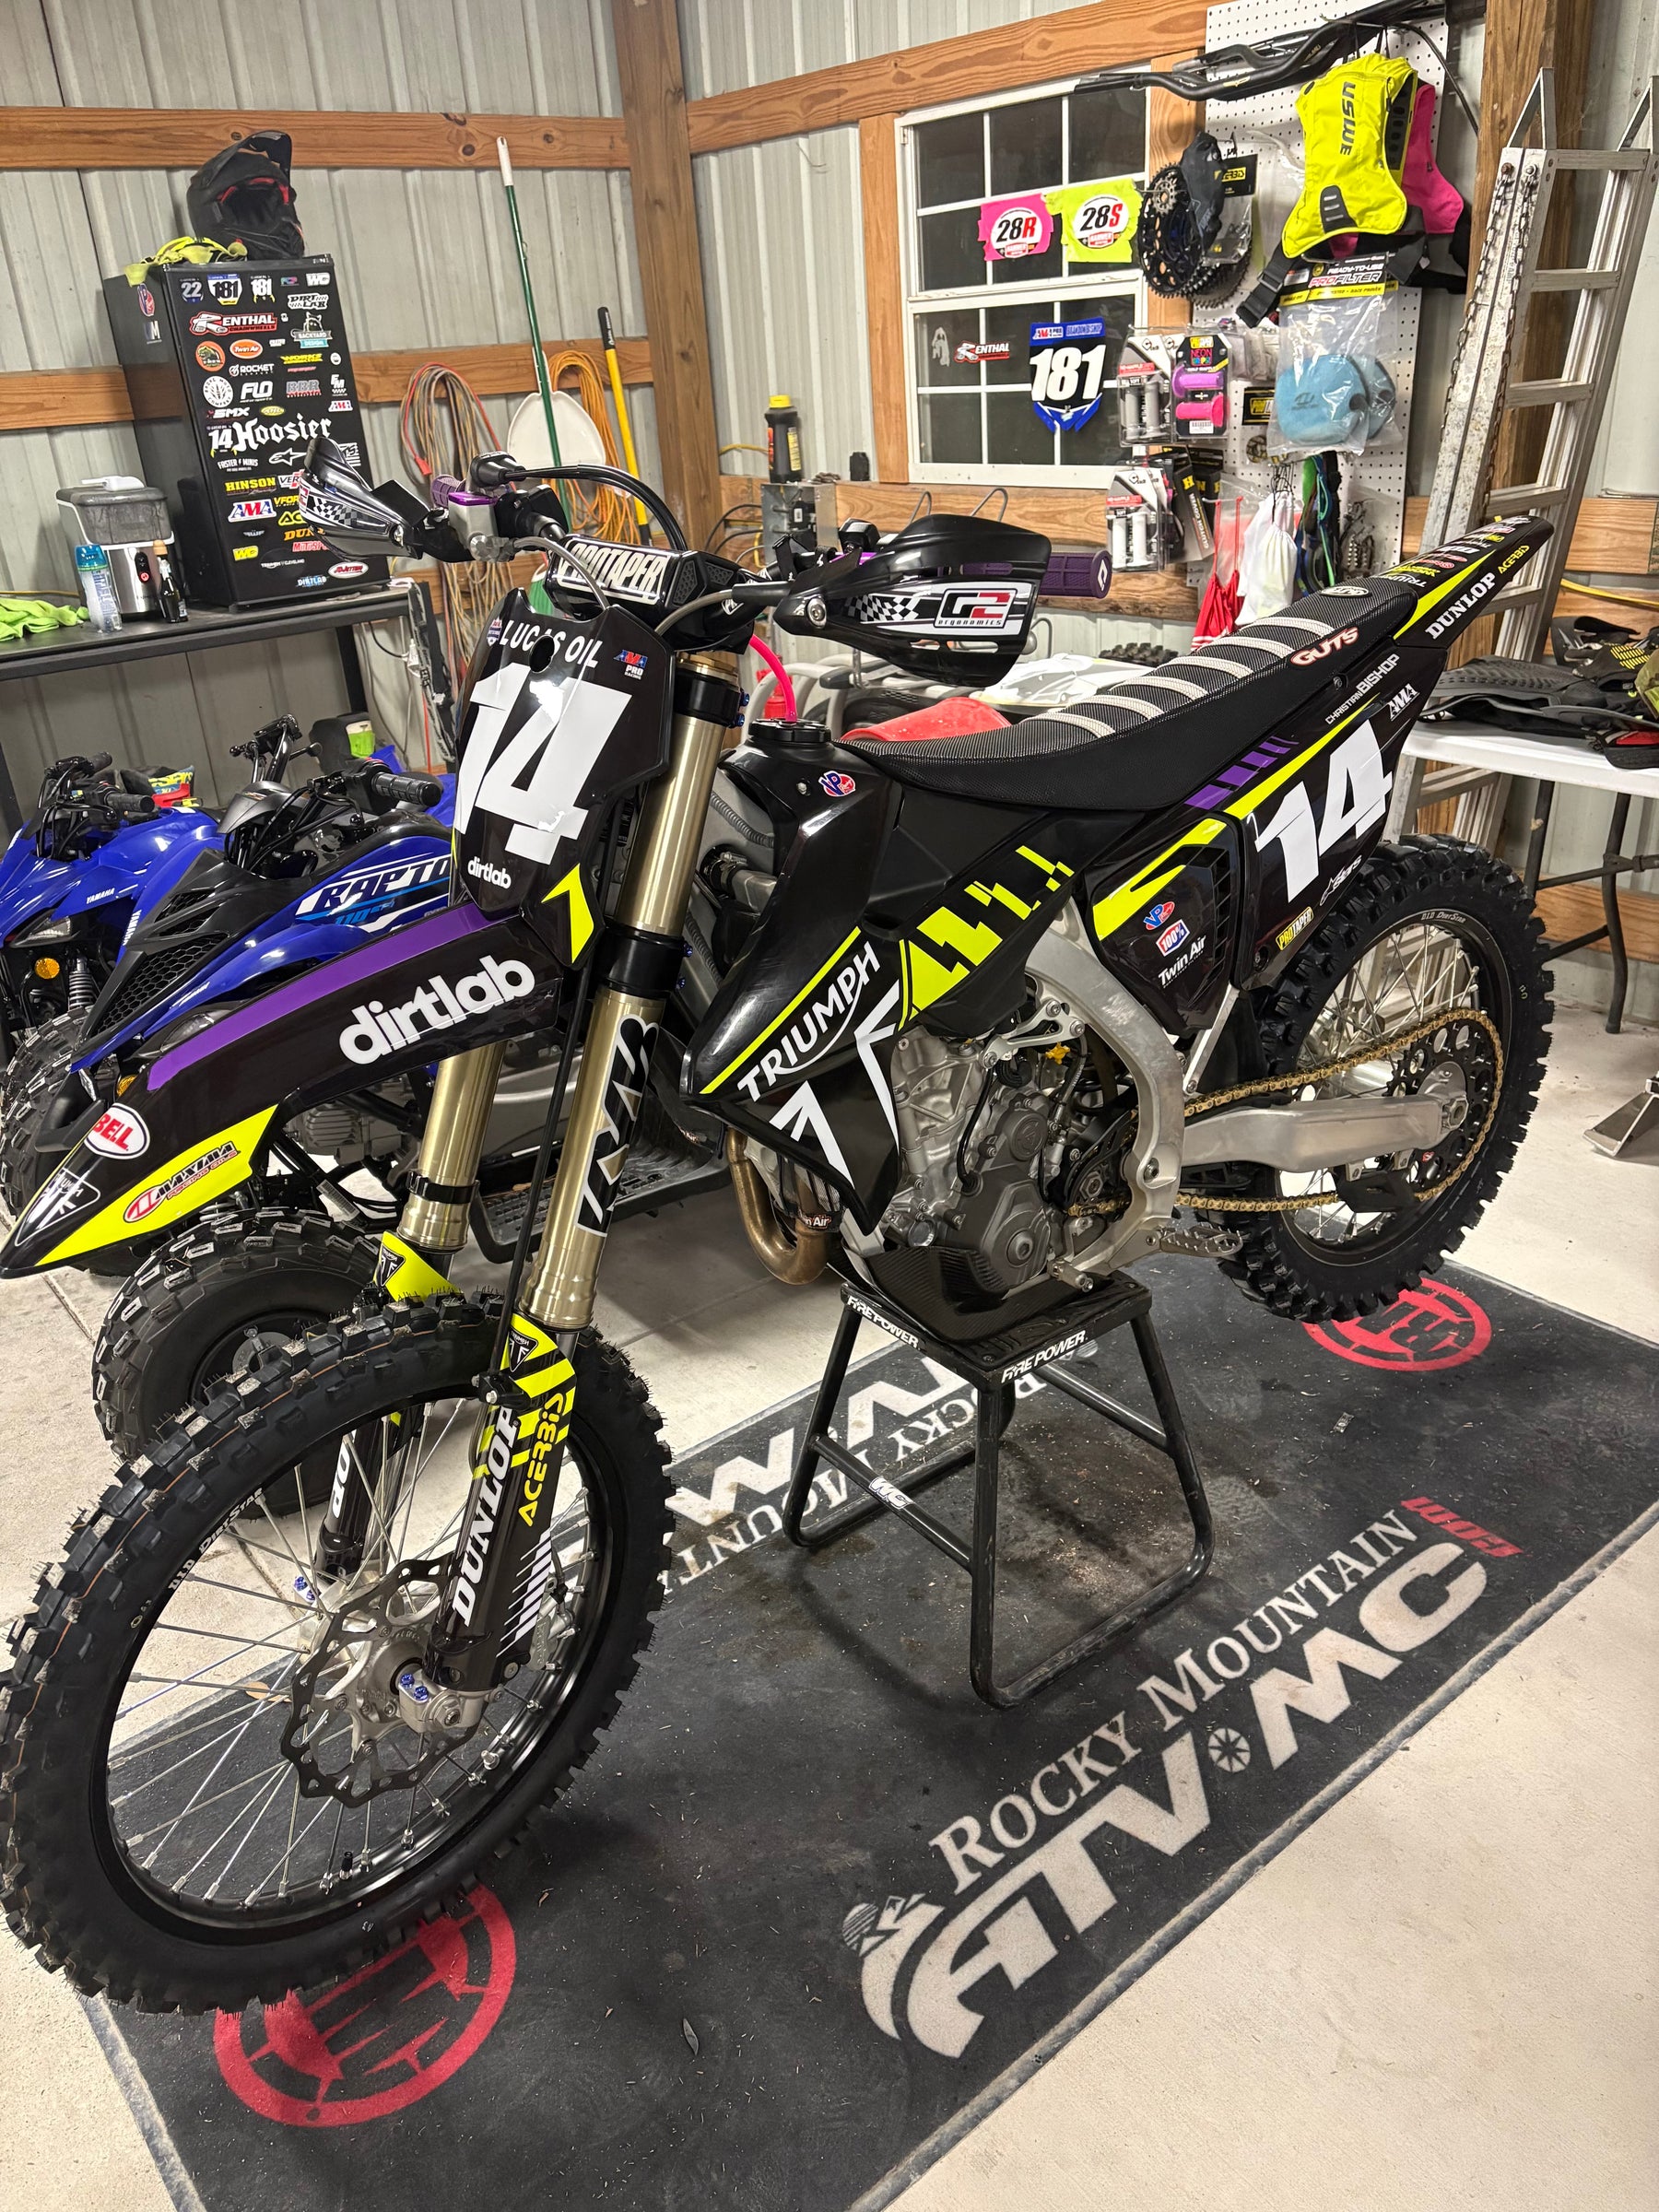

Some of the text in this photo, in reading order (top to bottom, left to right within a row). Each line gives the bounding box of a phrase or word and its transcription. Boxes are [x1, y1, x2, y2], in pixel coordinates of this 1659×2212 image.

[1340, 81, 1356, 156] USWE
[996, 217, 1037, 243] 28R
[1079, 203, 1123, 231] 28S
[181, 281, 203, 298] 22
[213, 280, 239, 299] 181
[251, 277, 273, 296] 181
[1309, 271, 1383, 288] PROFILTER
[192, 313, 276, 334] RENTHAL
[957, 342, 1009, 360] RENTHAL
[1191, 349, 1212, 358] NEON
[240, 363, 275, 373] ROCKET
[1029, 344, 1106, 402] 181
[240, 381, 274, 400] FLO
[212, 406, 251, 419] SMX
[208, 428, 234, 450] 14
[231, 413, 332, 452] Hoosier
[224, 477, 276, 492] HINSON
[230, 500, 274, 519] AMA
[1497, 544, 1530, 574] ACERBIS
[941, 592, 1011, 619] G2
[1425, 571, 1496, 640] DUNLOP
[937, 618, 1003, 628] ergonomics
[499, 620, 566, 658] LUCS
[564, 637, 604, 668] OIL
[613, 649, 649, 669] AMA
[1291, 627, 1359, 666] GUTS
[625, 665, 643, 677] PRO
[1325, 653, 1400, 725] CHRISTIAN BISHOP
[1387, 683, 1421, 722] AMA
[453, 662, 633, 865] 14
[818, 771, 842, 795] VP
[1254, 718, 1394, 904] 14
[317, 856, 452, 912] RAPTO
[467, 856, 512, 888] dirtlab
[86, 887, 115, 905] YAMAHA
[122, 909, 143, 947] YAMAHA
[1143, 903, 1165, 927] VP
[1277, 909, 1312, 947] PROTAPER
[1160, 924, 1185, 952] 100%
[1158, 952, 1189, 986] Twin
[1189, 935, 1206, 960] Air
[338, 953, 536, 1065] dirtlab
[736, 940, 882, 1103] TRIUMPH
[92, 1112, 130, 1151] BELL
[154, 1141, 235, 1200] MAXIMA
[847, 1295, 920, 1350] FIRE POWER
[1001, 1330, 1088, 1383] FIRE POWER
[518, 1393, 565, 1527] ACERBIS
[453, 1406, 522, 1628] DUNLOP
[929, 1509, 1420, 1894] ROCKY MOUNTAIN
[906, 1542, 1488, 2060] ATV MC
